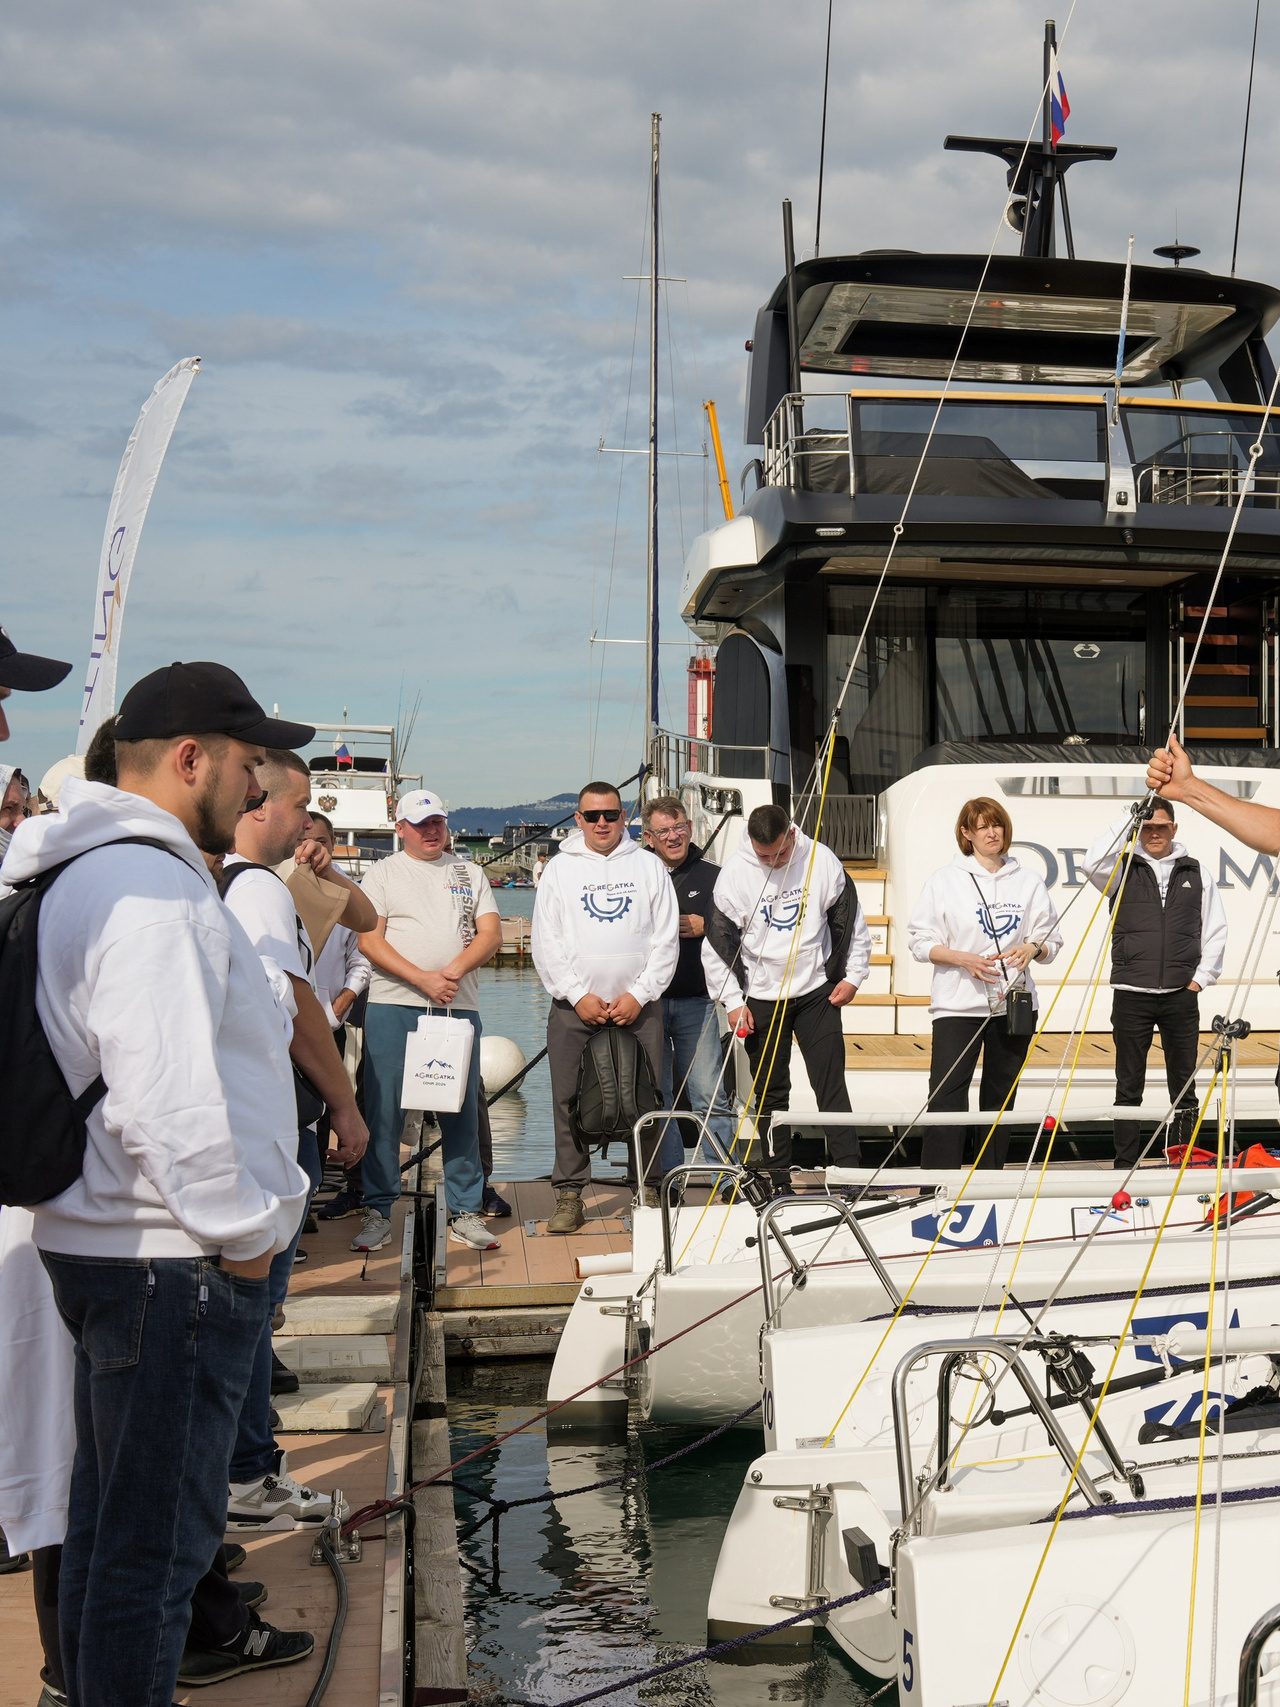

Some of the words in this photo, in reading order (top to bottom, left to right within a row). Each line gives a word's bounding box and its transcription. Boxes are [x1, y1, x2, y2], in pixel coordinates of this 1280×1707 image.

[451, 886, 473, 898] RAW
[582, 882, 635, 892] AGREGATKA
[761, 888, 805, 903] AGRGATK
[415, 1072, 455, 1080] AGREGATKA
[763, 1386, 774, 1431] 10
[903, 1628, 914, 1693] 5
